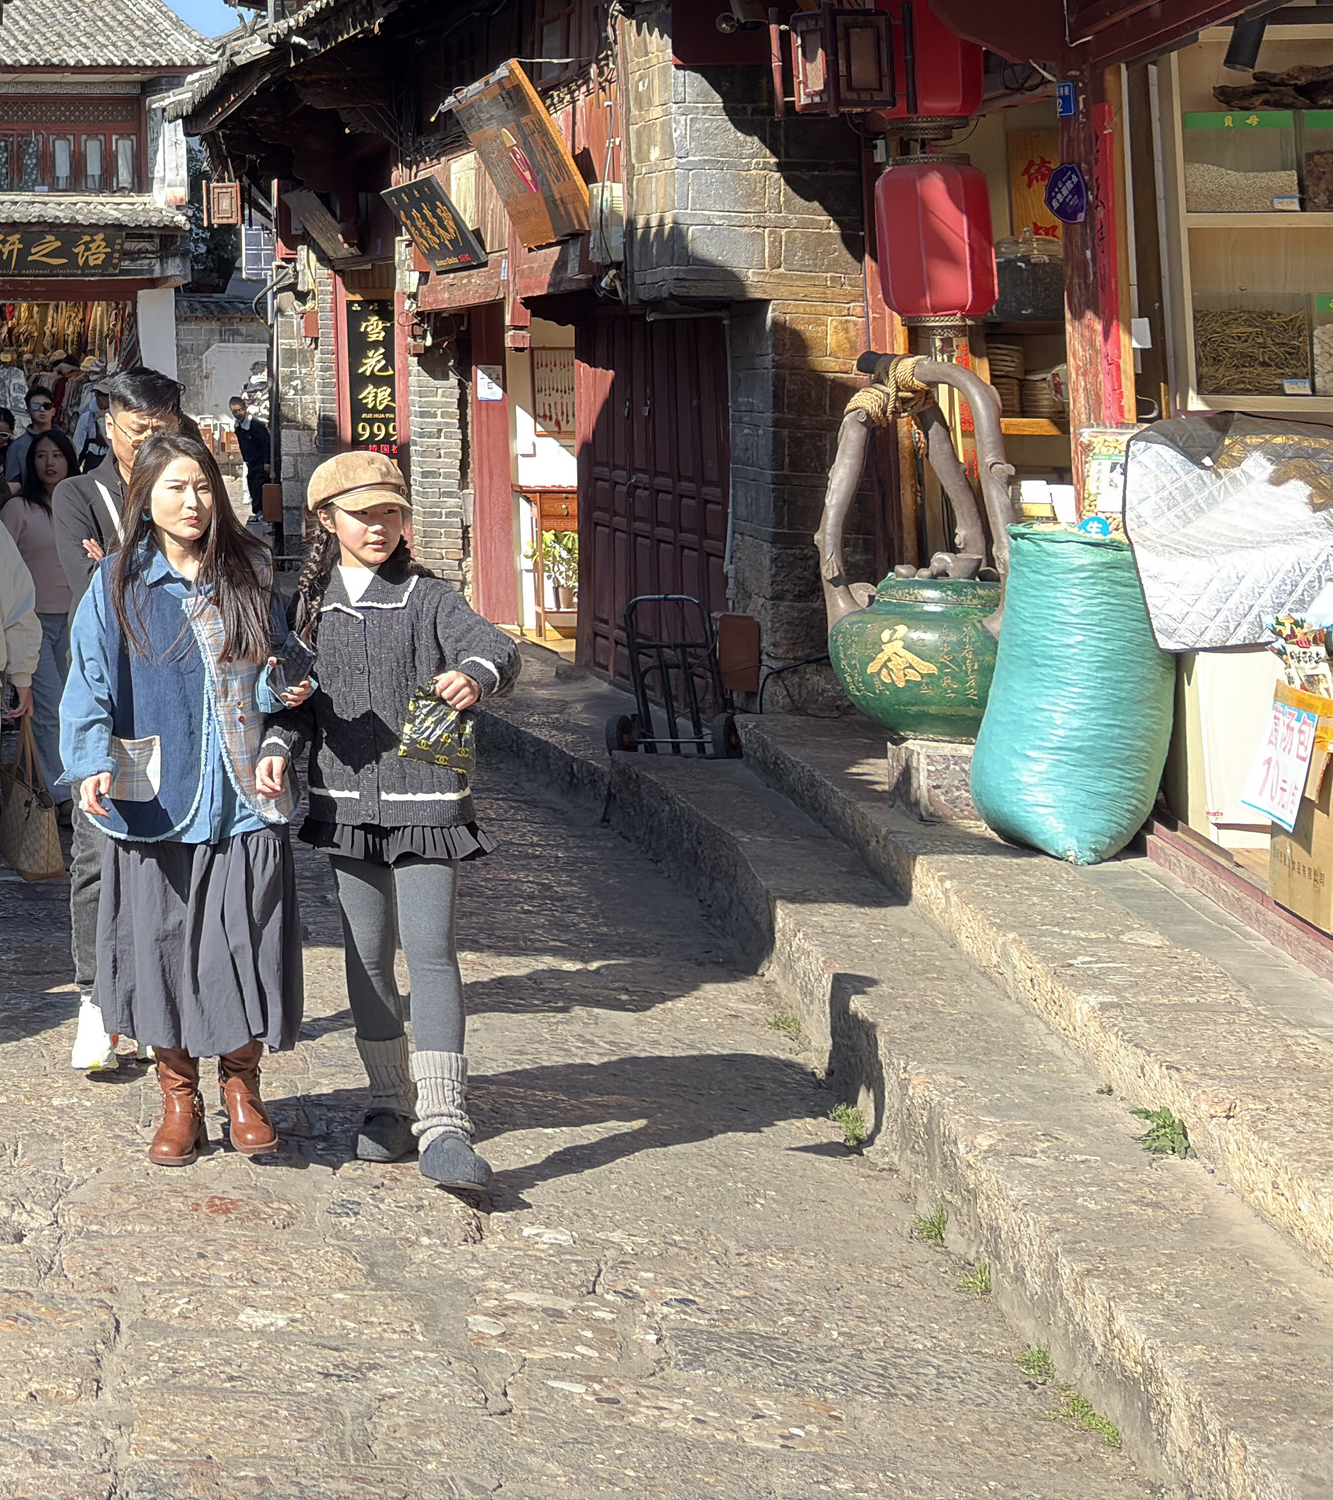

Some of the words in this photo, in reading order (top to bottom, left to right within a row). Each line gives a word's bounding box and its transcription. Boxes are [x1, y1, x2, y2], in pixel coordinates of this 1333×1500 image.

[357, 315, 396, 411] 雪花银
[867, 624, 939, 688] 茶
